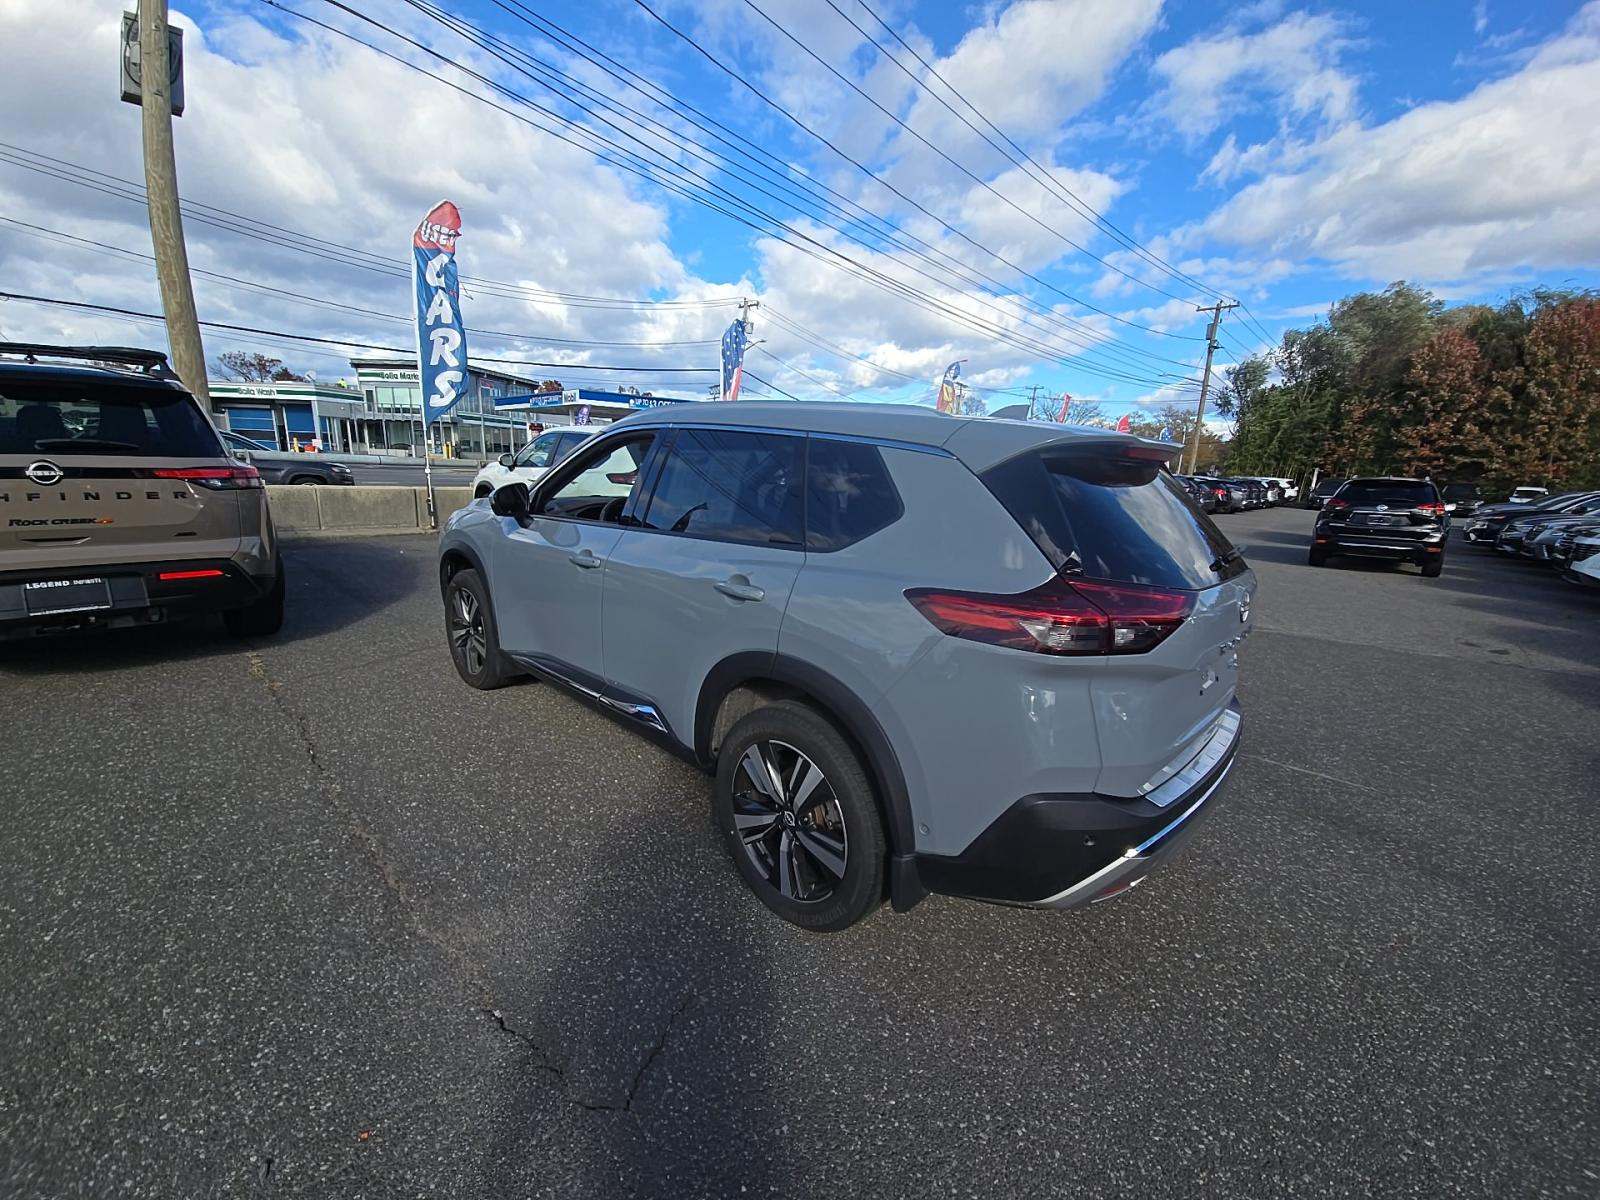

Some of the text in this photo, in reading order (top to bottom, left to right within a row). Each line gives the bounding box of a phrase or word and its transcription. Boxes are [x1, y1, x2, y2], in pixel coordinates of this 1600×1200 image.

[425, 252, 463, 407] CARS
[51, 518, 97, 526] CREEK
[26, 580, 70, 590] LEGEND
